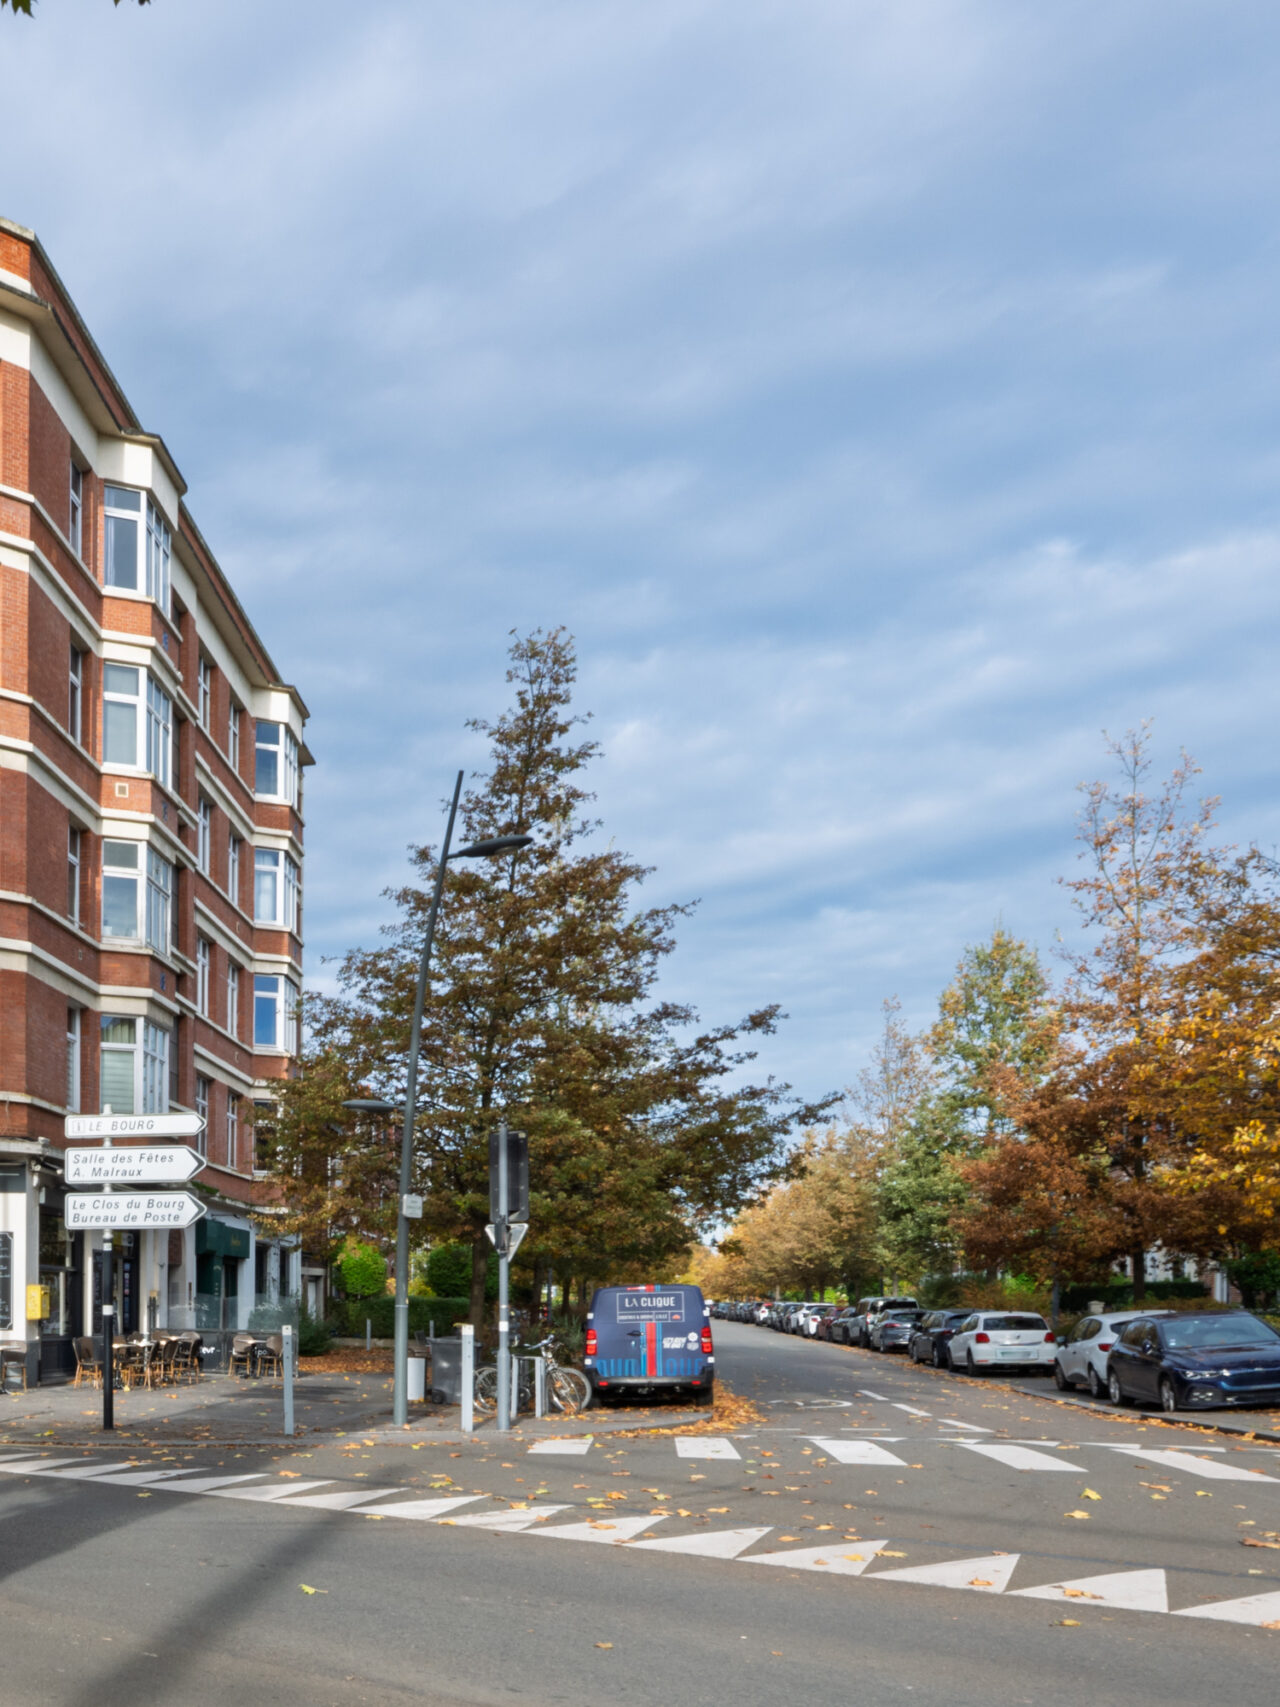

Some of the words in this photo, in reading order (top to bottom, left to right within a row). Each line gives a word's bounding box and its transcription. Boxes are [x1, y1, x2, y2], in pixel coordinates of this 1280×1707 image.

[89, 1121, 102, 1131] LE
[111, 1120, 155, 1131] BOURG
[73, 1154, 105, 1164] Salle
[111, 1154, 133, 1163] des
[138, 1152, 174, 1163] Fêtes
[73, 1167, 85, 1177] A.
[91, 1167, 143, 1177] Malraux
[72, 1200, 87, 1210] Le
[92, 1200, 120, 1209] Clos
[126, 1200, 141, 1209] du
[146, 1199, 185, 1211] Bourg
[72, 1213, 117, 1223] Bureau
[123, 1213, 138, 1222] de
[144, 1212, 180, 1222] Poste
[625, 1298, 638, 1307] LA
[641, 1297, 675, 1308] CLIQUE
